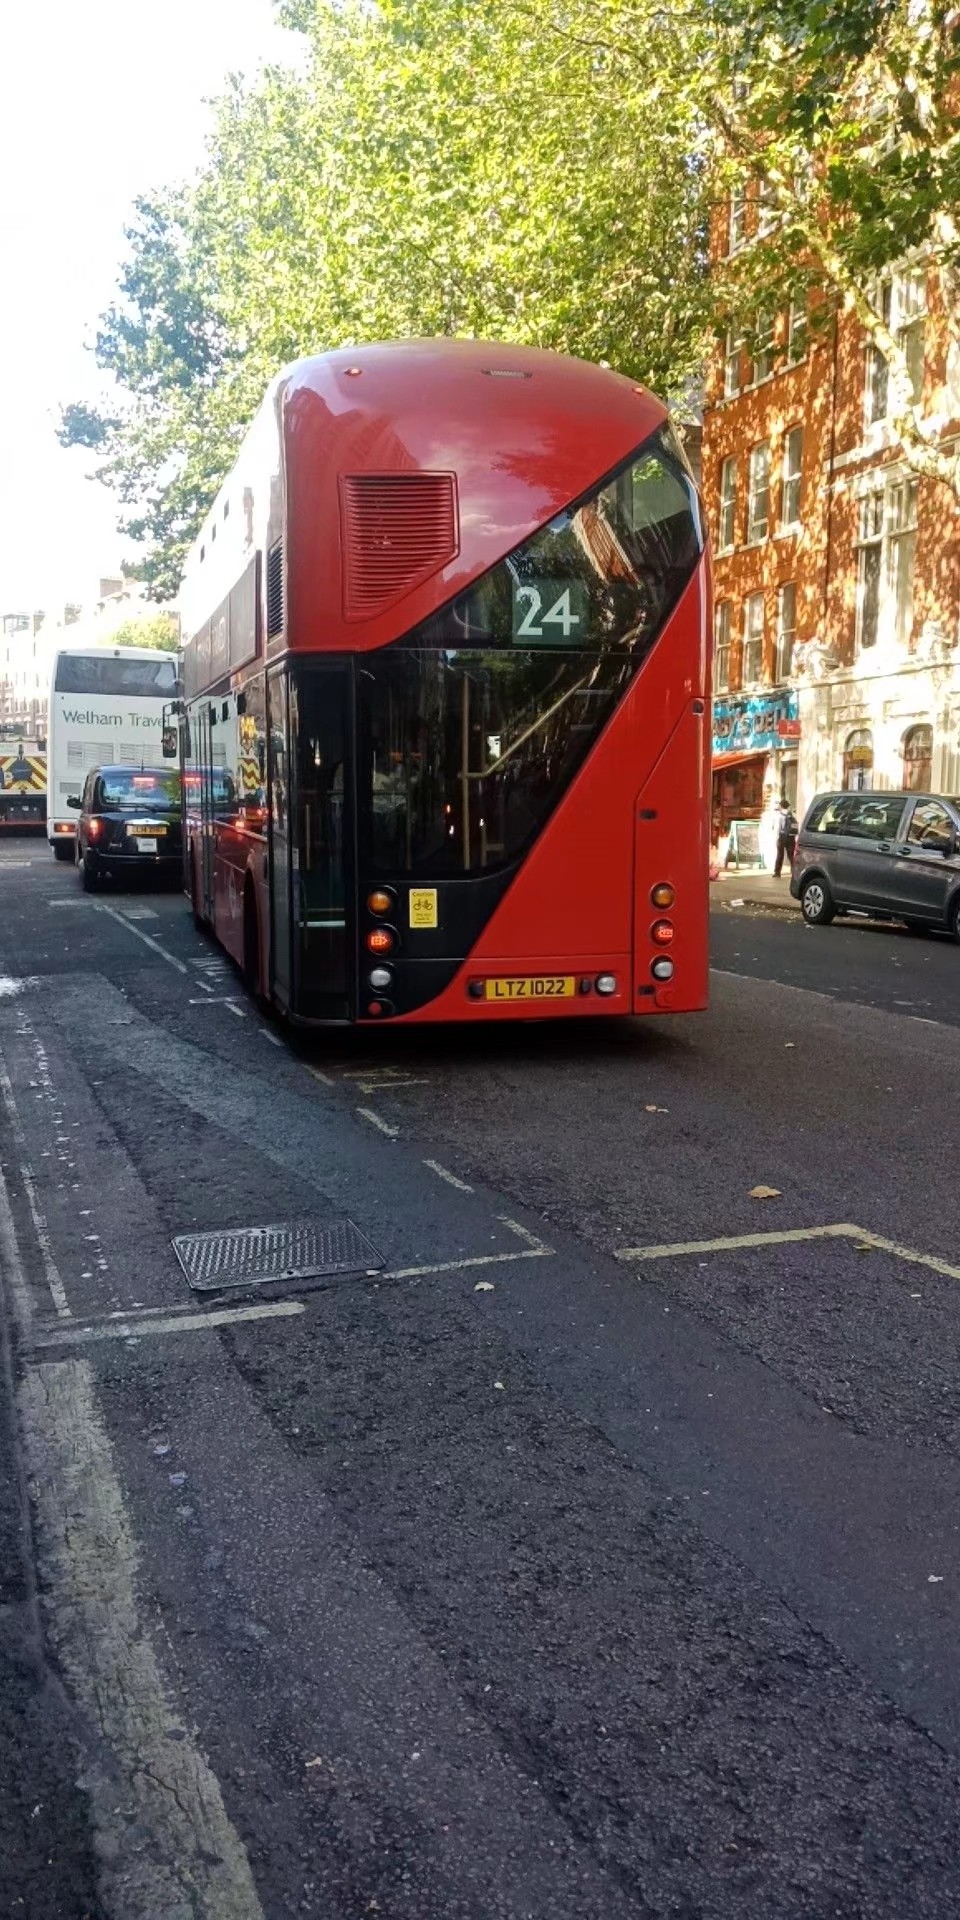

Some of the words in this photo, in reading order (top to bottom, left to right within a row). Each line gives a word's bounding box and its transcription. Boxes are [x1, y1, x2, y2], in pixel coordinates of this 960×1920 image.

[516, 586, 579, 636] 24
[62, 710, 122, 725] Welham
[128, 713, 170, 728] Travel
[495, 981, 526, 997] LTZ
[530, 979, 565, 995] 1022
